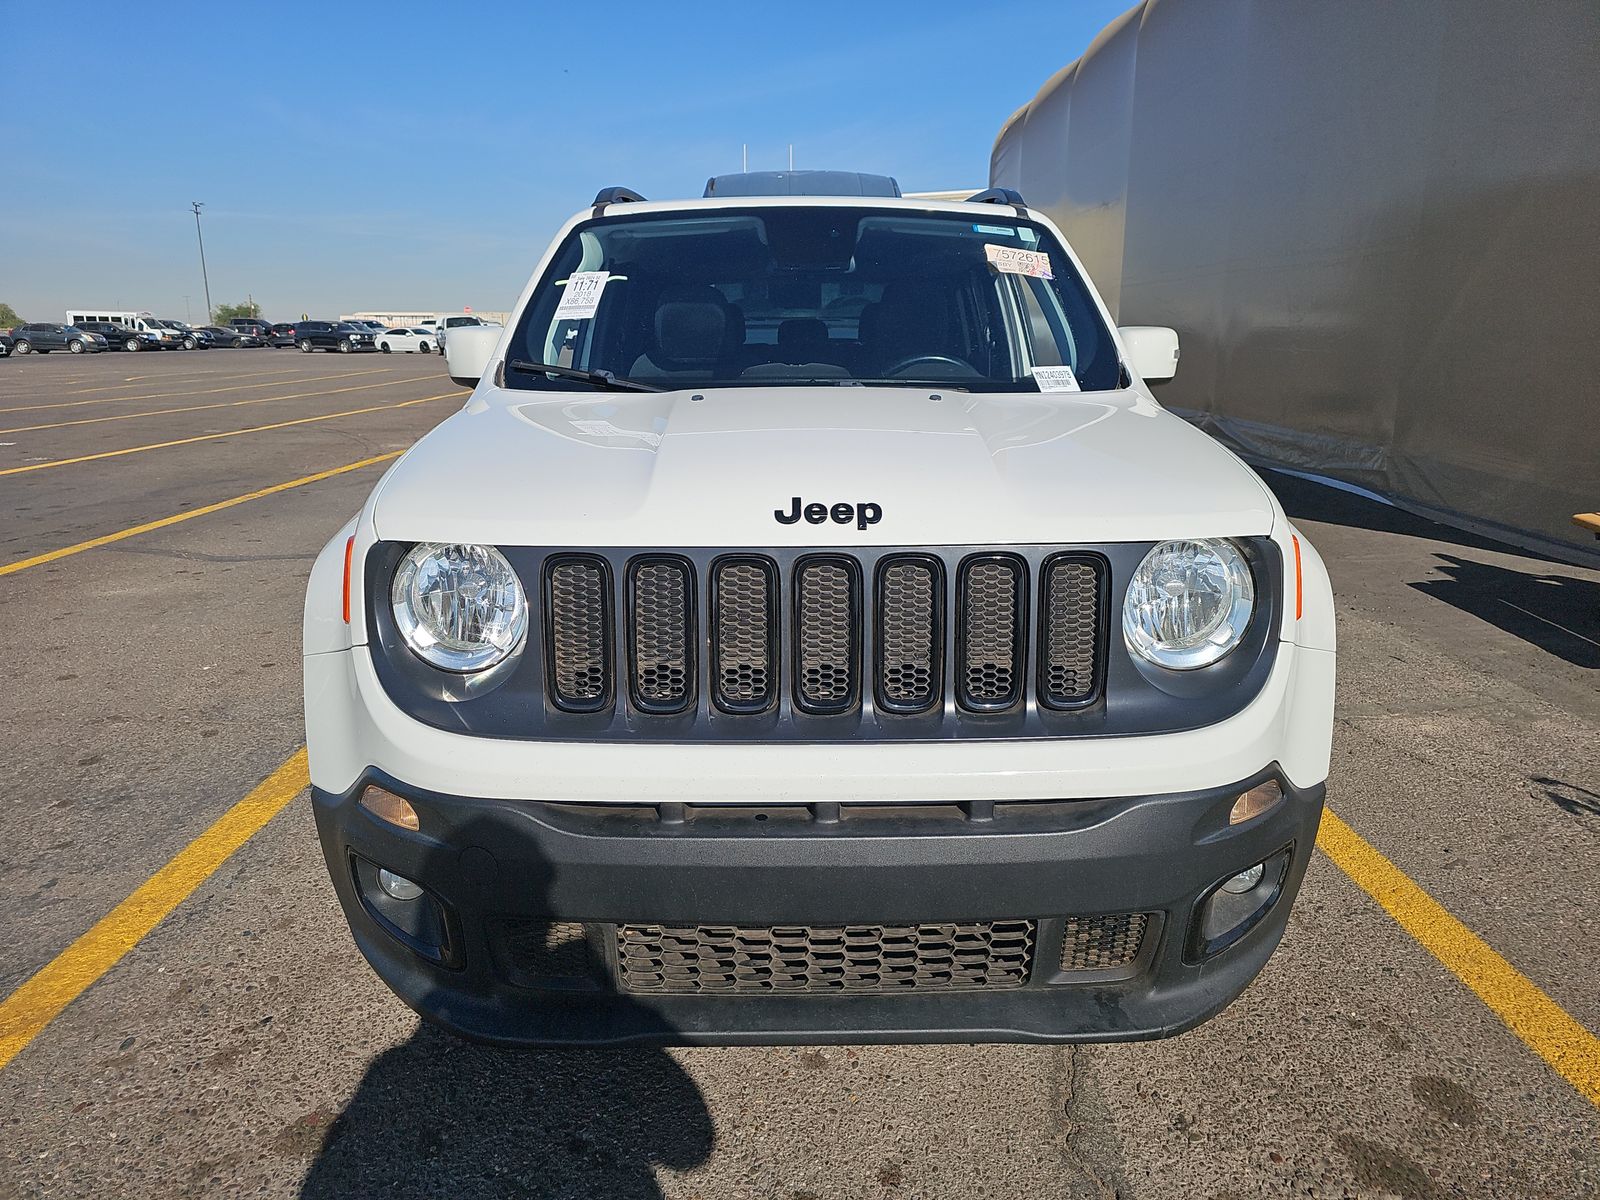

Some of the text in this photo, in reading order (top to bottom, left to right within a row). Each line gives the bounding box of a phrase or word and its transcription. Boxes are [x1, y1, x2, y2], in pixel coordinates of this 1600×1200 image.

[993, 249, 1048, 265] 7572615
[574, 280, 598, 291] 11:71
[774, 496, 883, 530] Jeep
